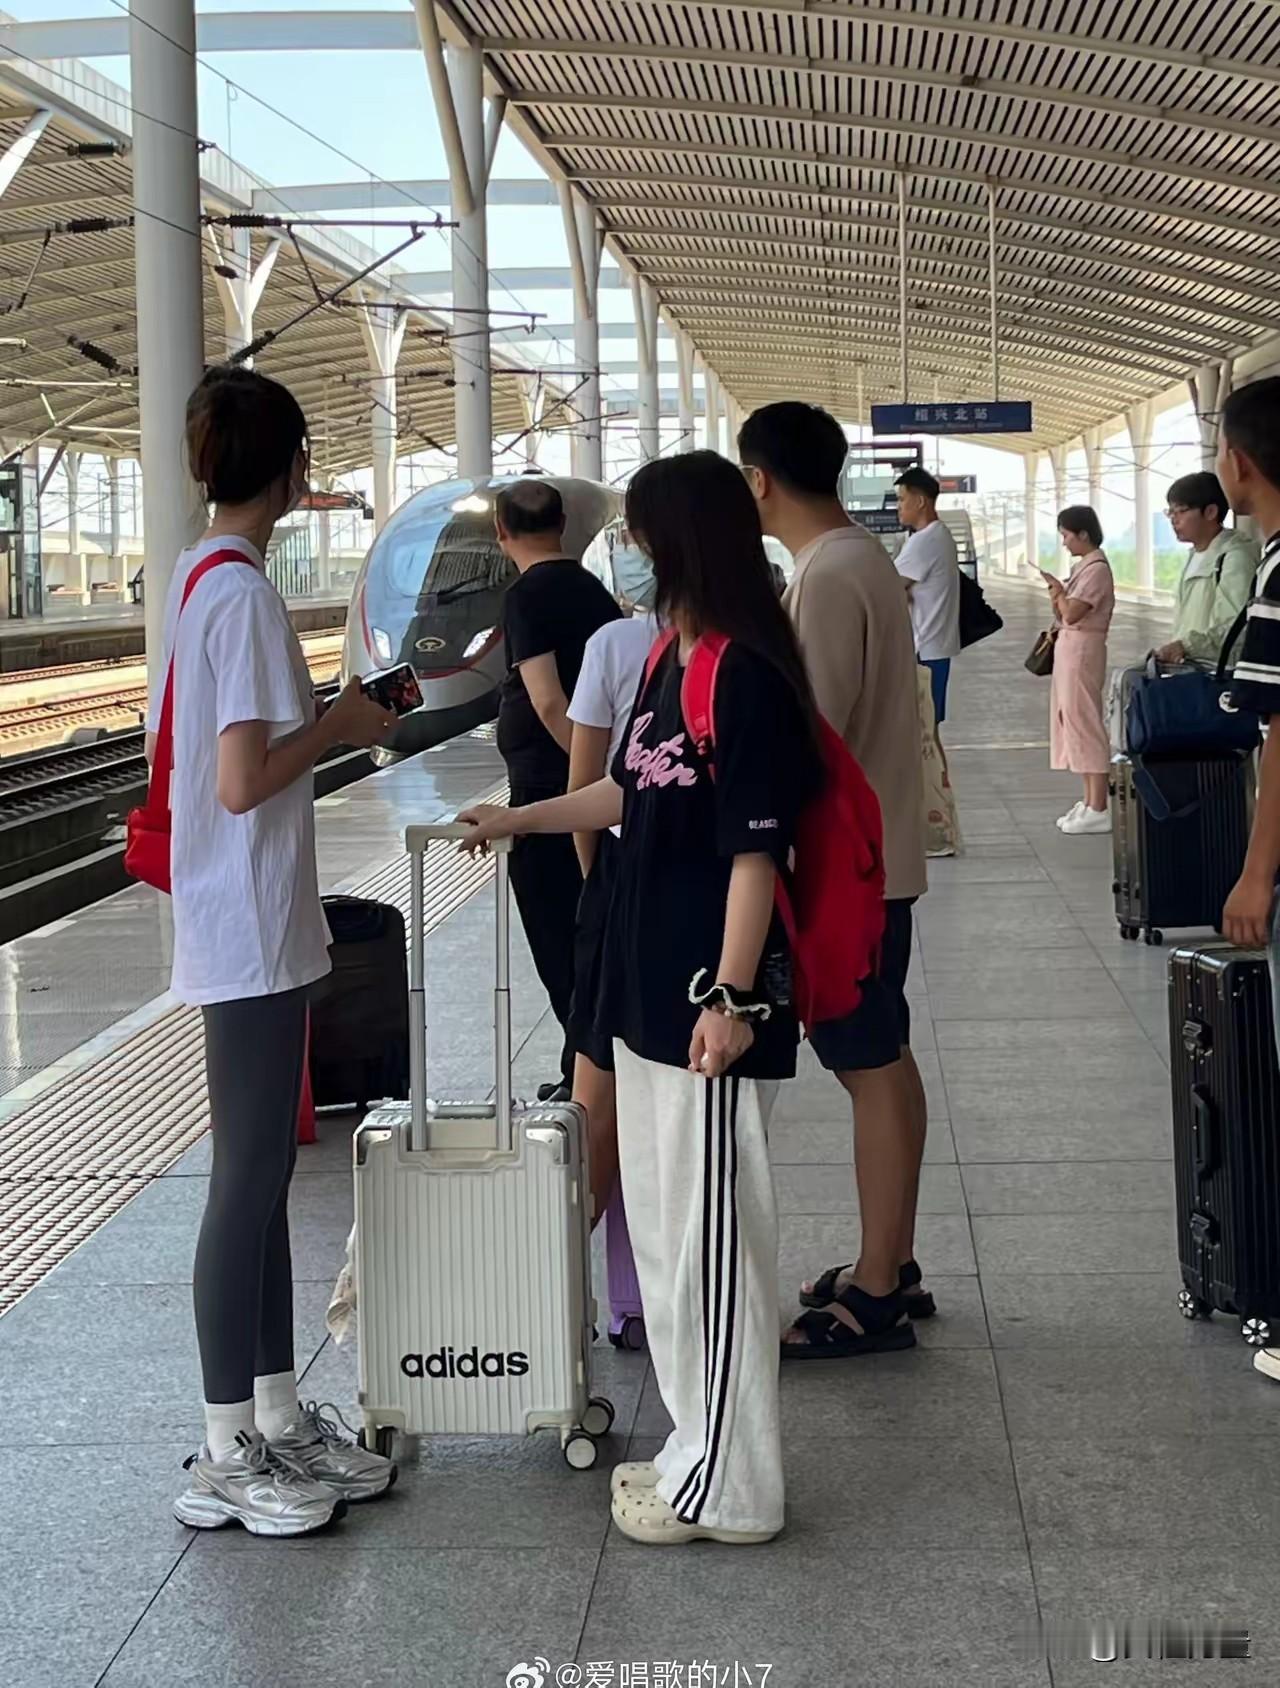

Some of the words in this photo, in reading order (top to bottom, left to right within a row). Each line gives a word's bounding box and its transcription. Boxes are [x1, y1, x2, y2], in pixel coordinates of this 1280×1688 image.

[914, 408, 988, 421] 绍兴北站
[400, 1346, 529, 1378] adidas
